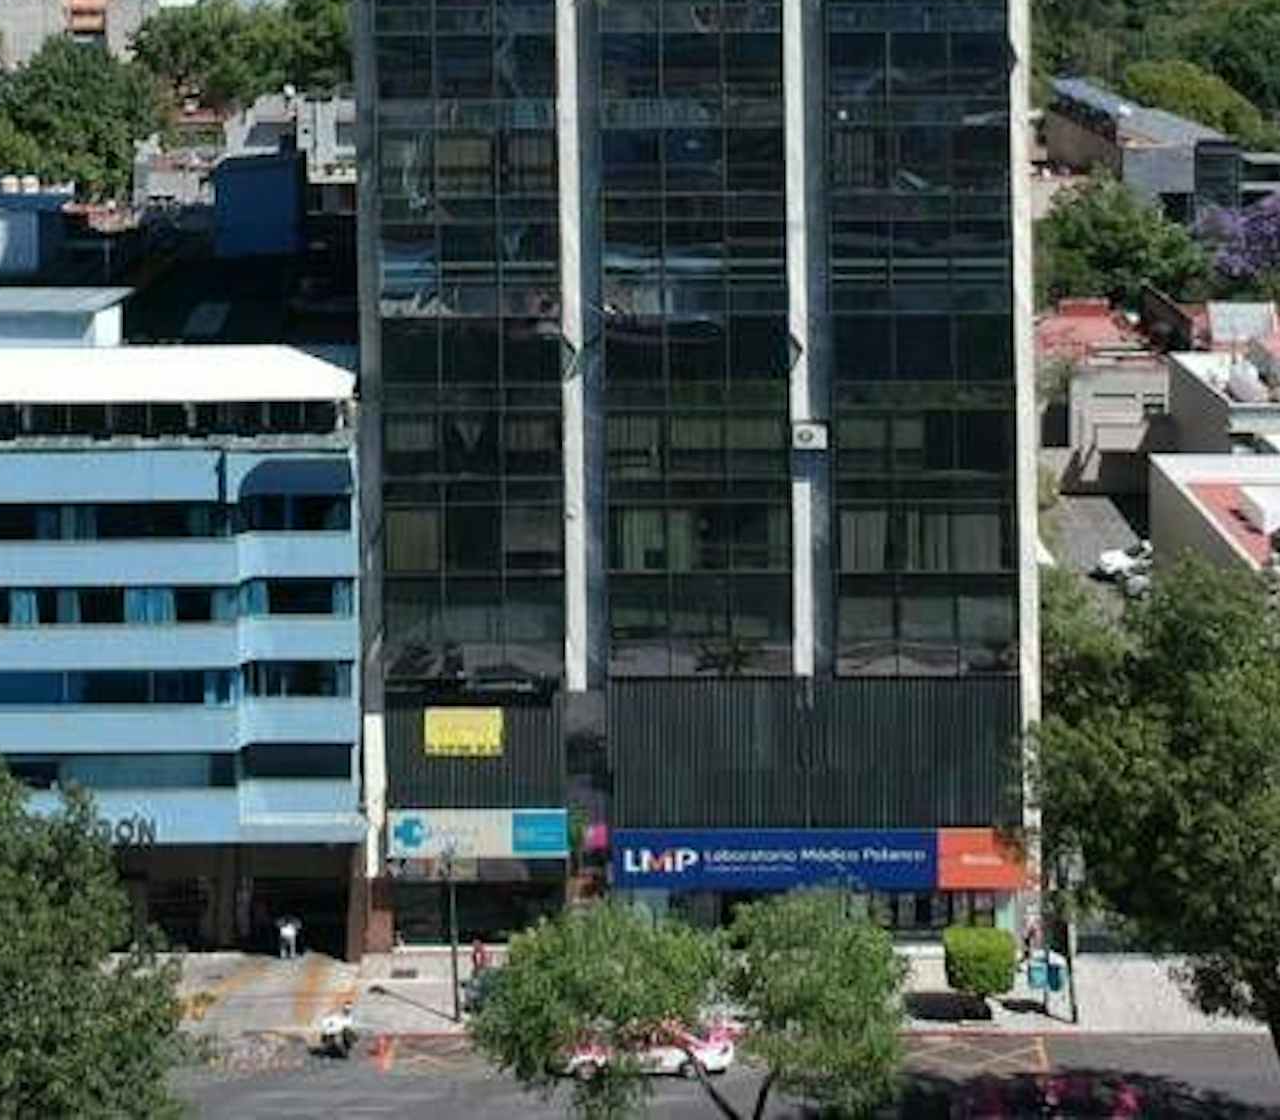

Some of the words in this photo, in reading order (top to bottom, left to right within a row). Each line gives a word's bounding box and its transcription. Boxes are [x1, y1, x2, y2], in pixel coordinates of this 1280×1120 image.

[623, 847, 699, 873] LMP
[703, 848, 797, 863] Laboratorio
[863, 846, 927, 863] Polanco
